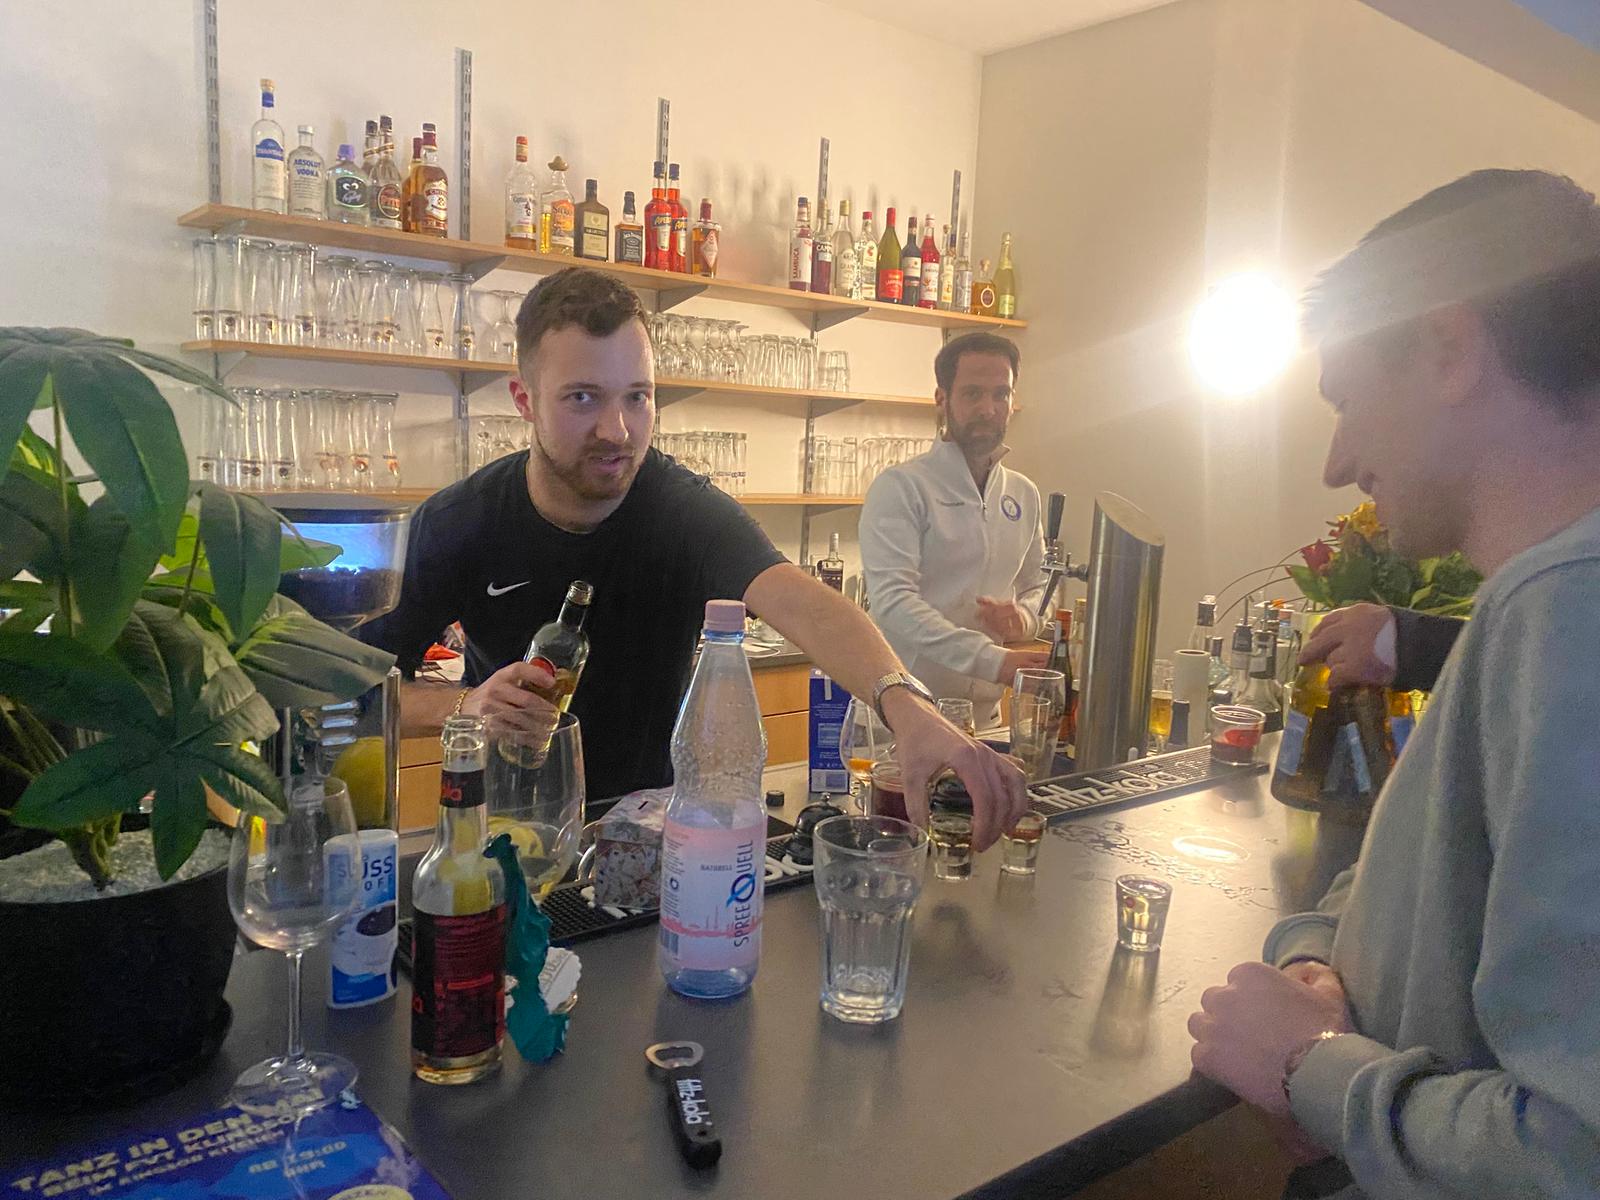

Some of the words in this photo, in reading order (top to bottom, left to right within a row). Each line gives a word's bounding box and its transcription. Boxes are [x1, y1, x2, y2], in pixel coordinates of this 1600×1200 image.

[10, 1152, 120, 1192] TANZ
[127, 1137, 169, 1159] IN
[177, 1113, 253, 1144] DEN
